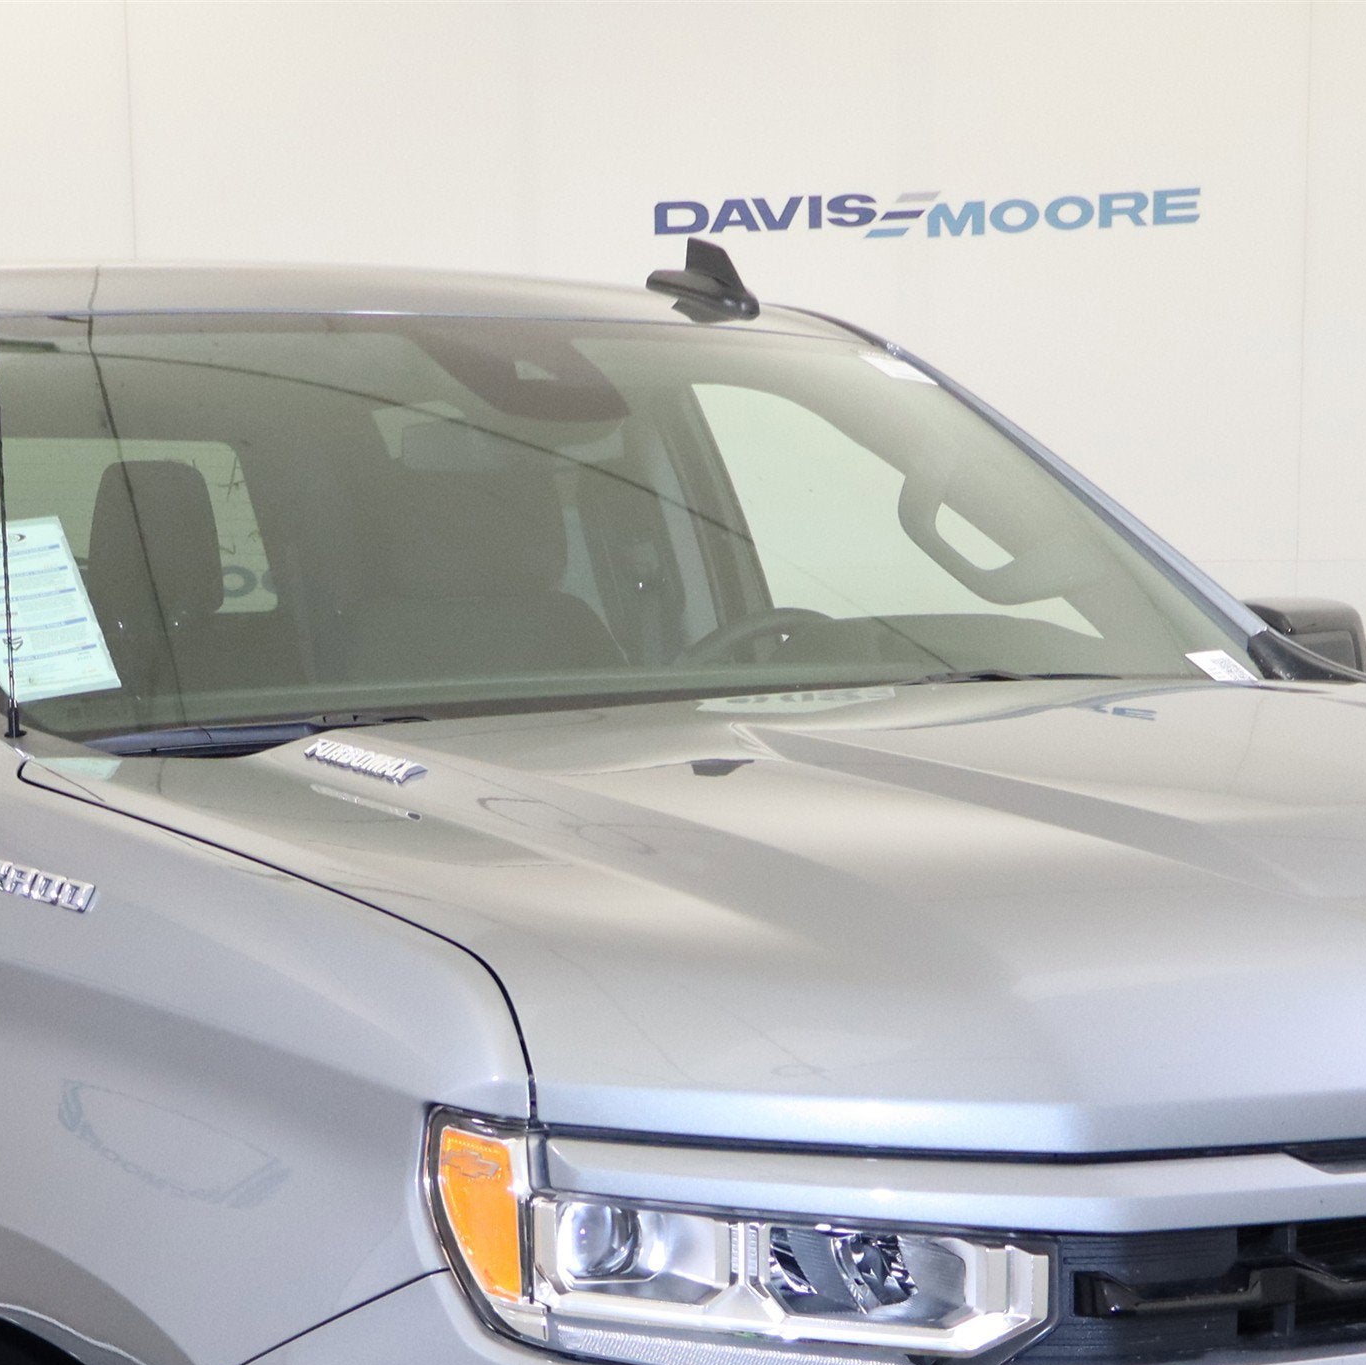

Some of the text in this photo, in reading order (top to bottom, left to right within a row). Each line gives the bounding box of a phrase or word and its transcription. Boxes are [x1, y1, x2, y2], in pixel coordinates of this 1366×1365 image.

[653, 187, 1201, 238] DAVIS MOORE
[303, 738, 427, 785] TURBOMAX
